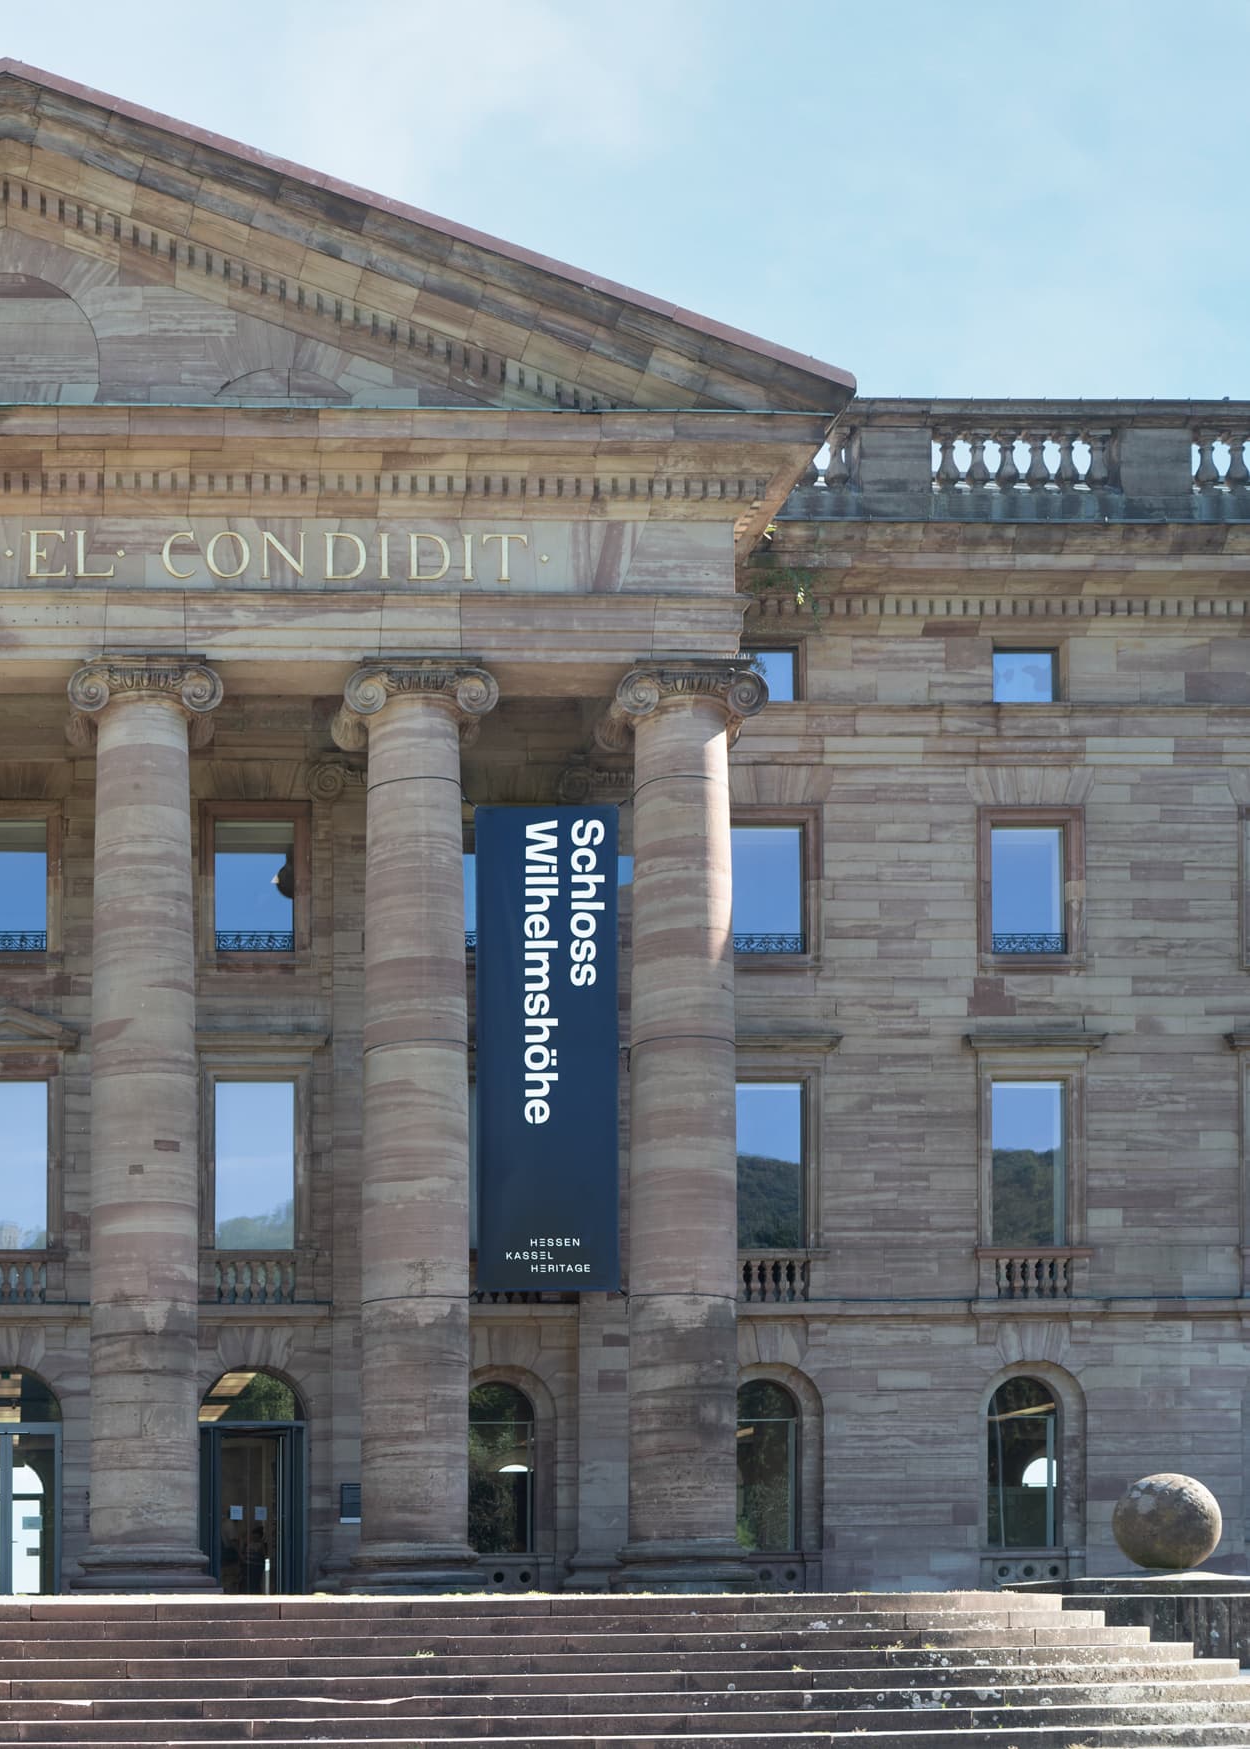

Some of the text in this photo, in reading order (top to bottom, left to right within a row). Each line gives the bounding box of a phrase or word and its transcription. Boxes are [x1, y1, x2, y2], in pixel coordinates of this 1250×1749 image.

[569, 818, 606, 988] Schloss
[523, 819, 559, 1125] Wilhelmshöhe
[530, 1238, 581, 1247] HESSEN
[505, 1251, 554, 1260] KASSEL
[530, 1263, 591, 1273] HERITAGE
